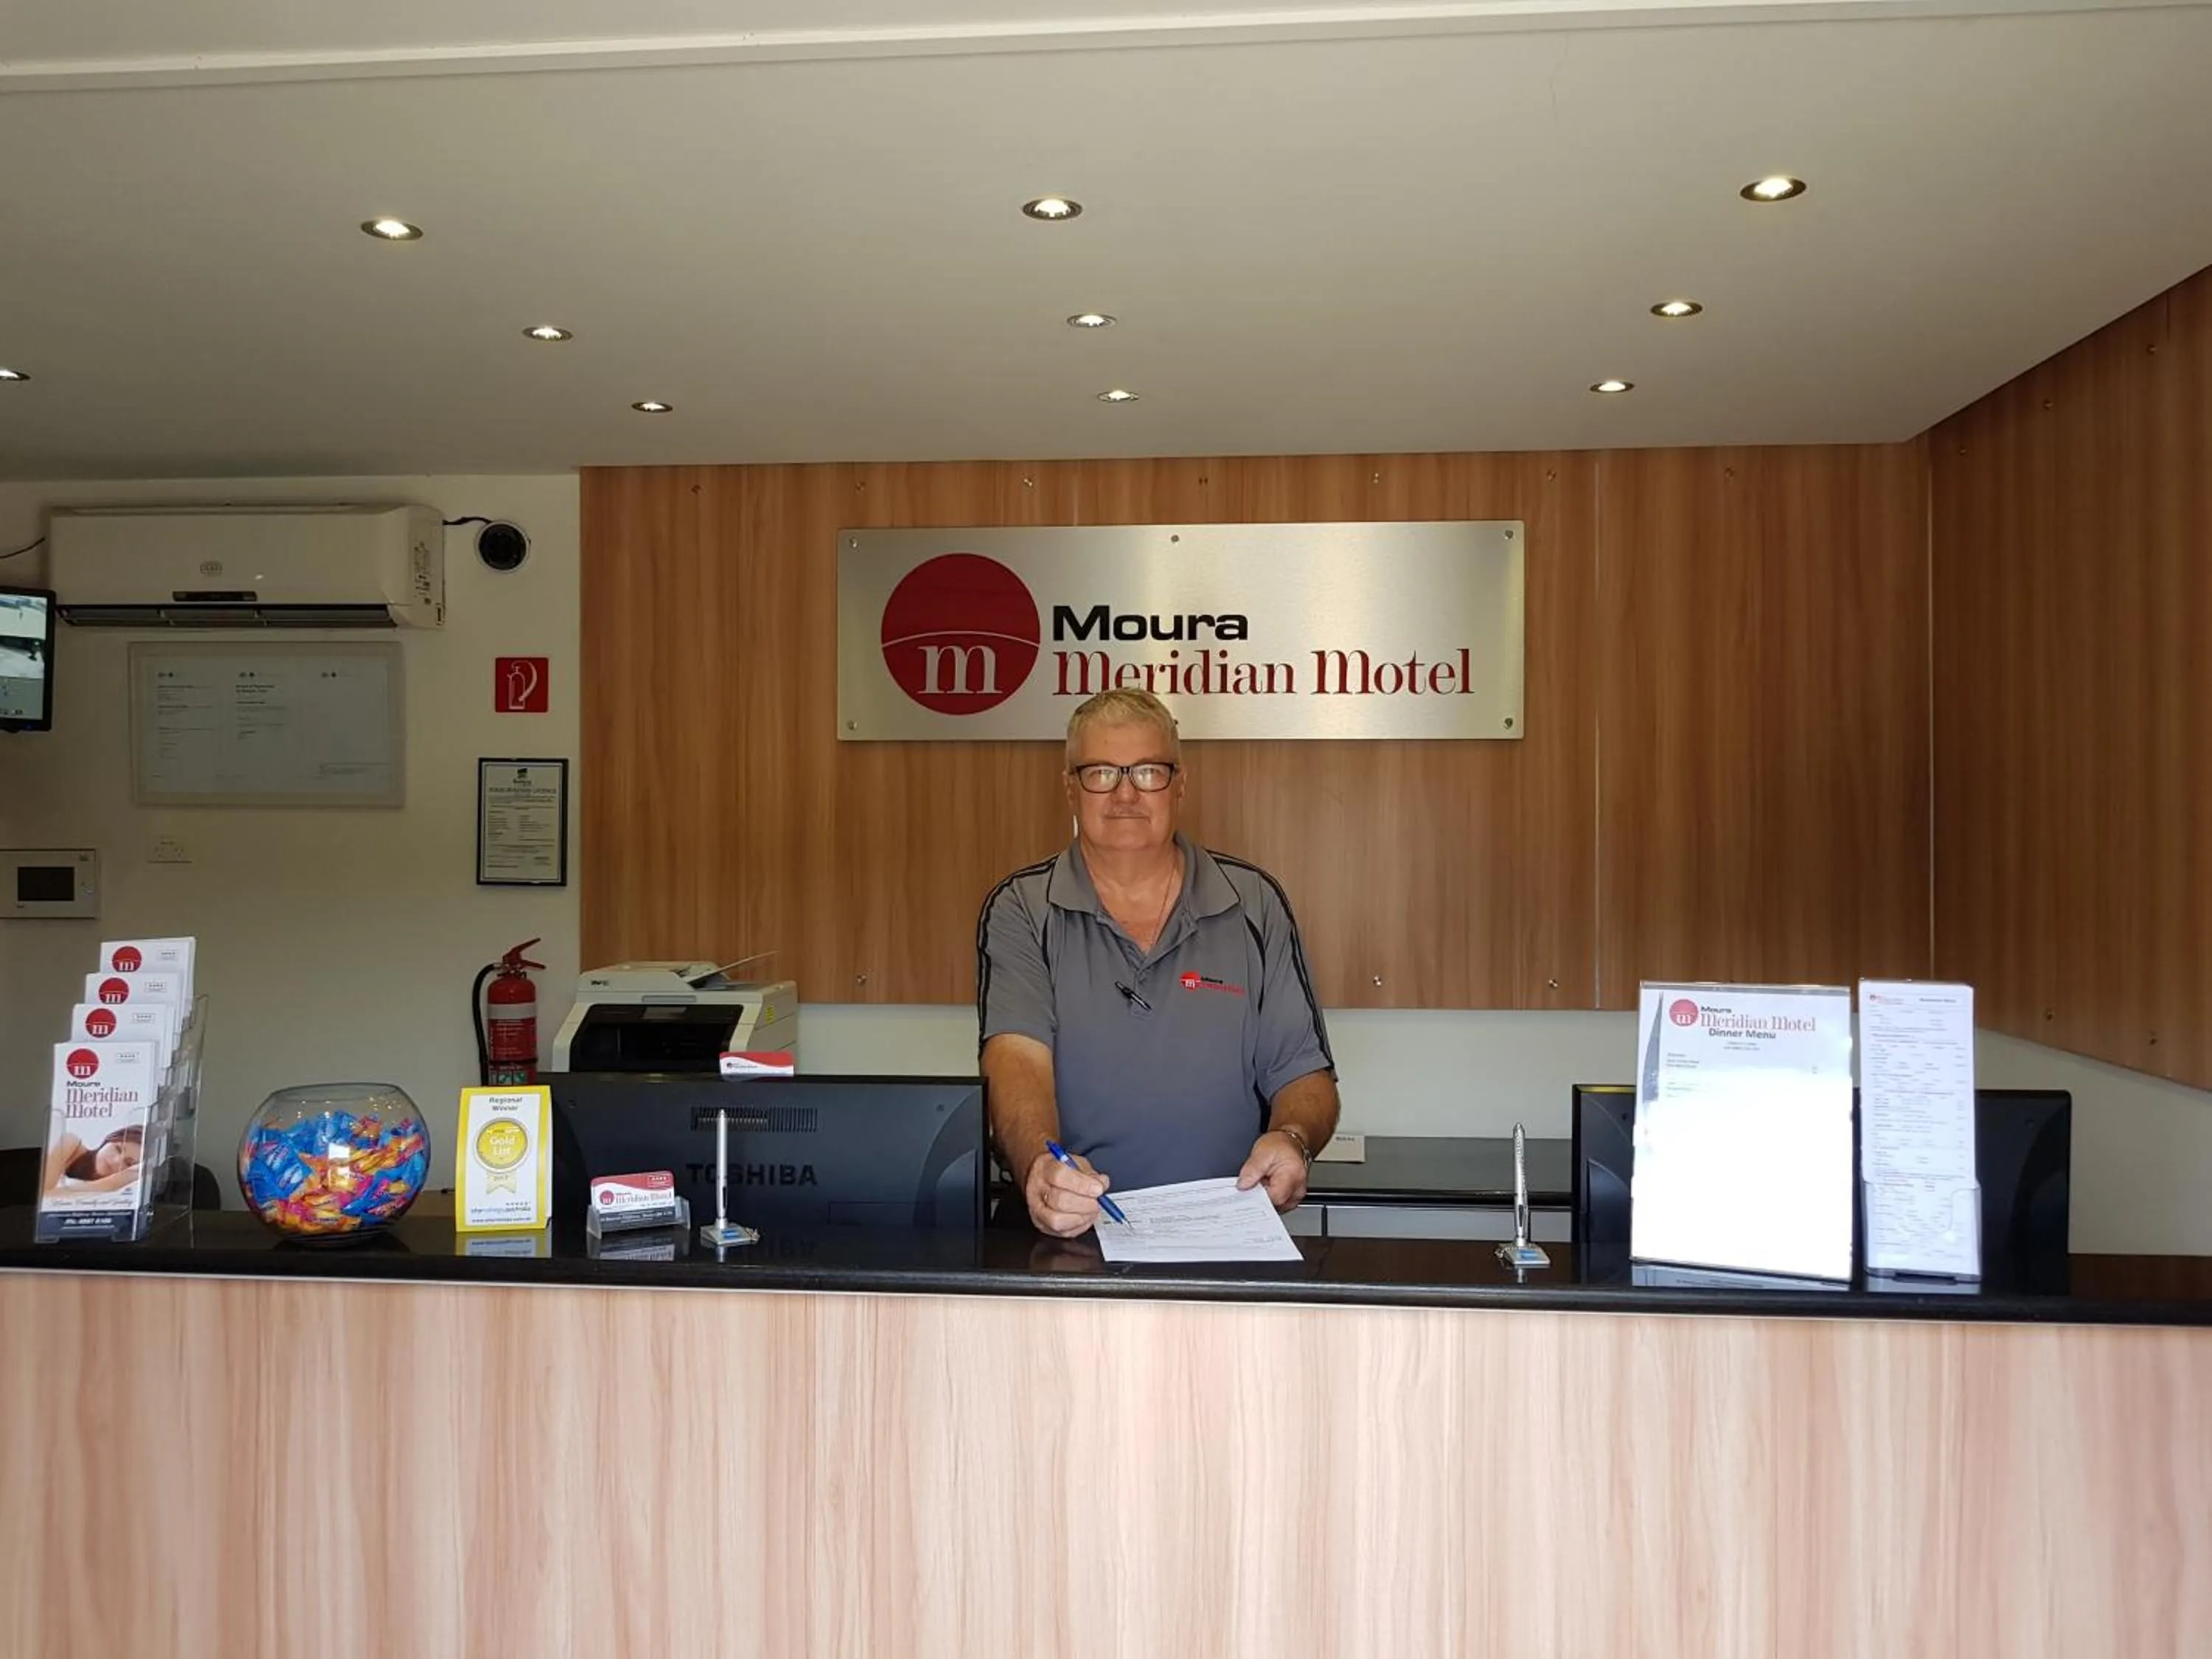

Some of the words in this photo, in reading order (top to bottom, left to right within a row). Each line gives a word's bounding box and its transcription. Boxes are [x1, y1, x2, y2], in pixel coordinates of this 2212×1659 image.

[1053, 605, 1249, 641] Moura
[918, 645, 1004, 694] m
[1052, 649, 1298, 696] Meridian
[1310, 647, 1475, 696] Motel
[1701, 1006, 1732, 1014] Moura
[1700, 1013, 1768, 1030] Meridian
[1771, 1015, 1816, 1032] Motel
[1708, 1028, 1742, 1037] Dinner
[1745, 1029, 1776, 1039] Menu
[66, 1088, 139, 1104] Meridian
[489, 1096, 523, 1105] Regional
[66, 1103, 113, 1119] Motel
[490, 1135, 515, 1146] Gold
